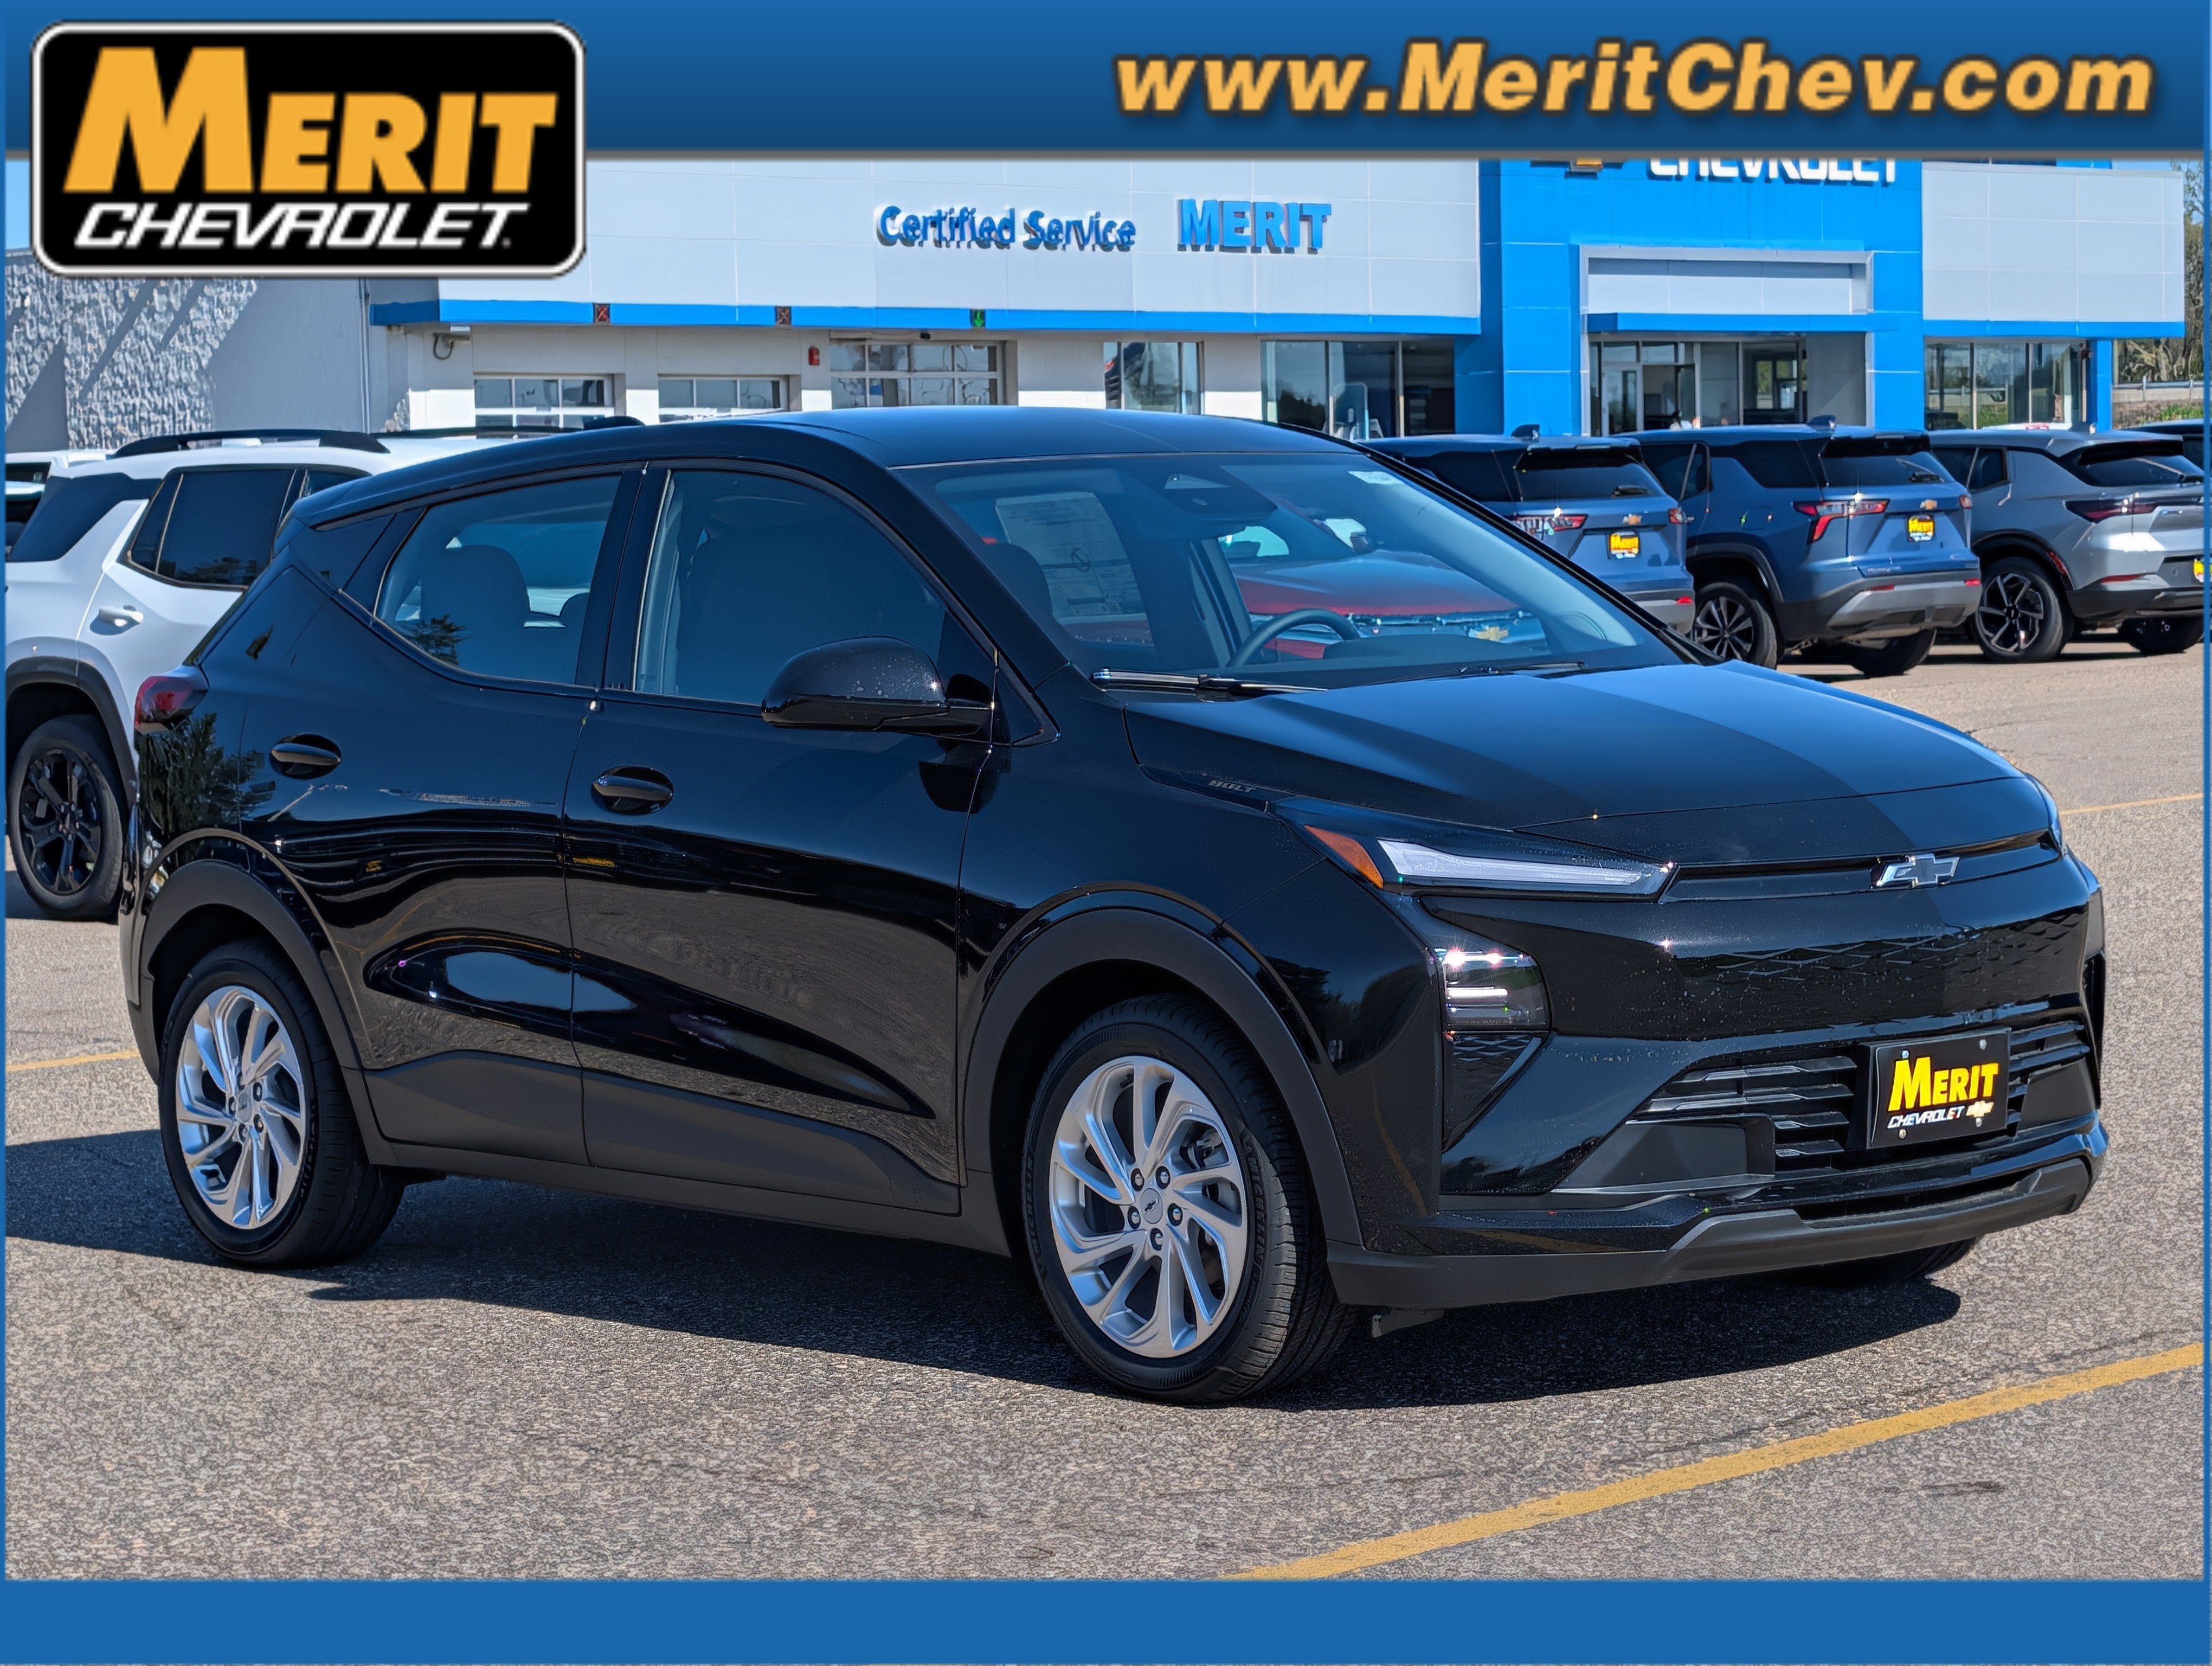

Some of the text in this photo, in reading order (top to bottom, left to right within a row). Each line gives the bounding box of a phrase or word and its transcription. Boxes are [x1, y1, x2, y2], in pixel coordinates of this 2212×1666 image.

[878, 206, 1136, 249] Certified Service
[1178, 198, 1332, 250] MERIT
[1208, 779, 1256, 793] BOLT
[1888, 1056, 1999, 1112] MERIT
[1887, 1106, 1965, 1129] CHEVROLET
[1248, 1157, 1265, 1263] MICHELIN
